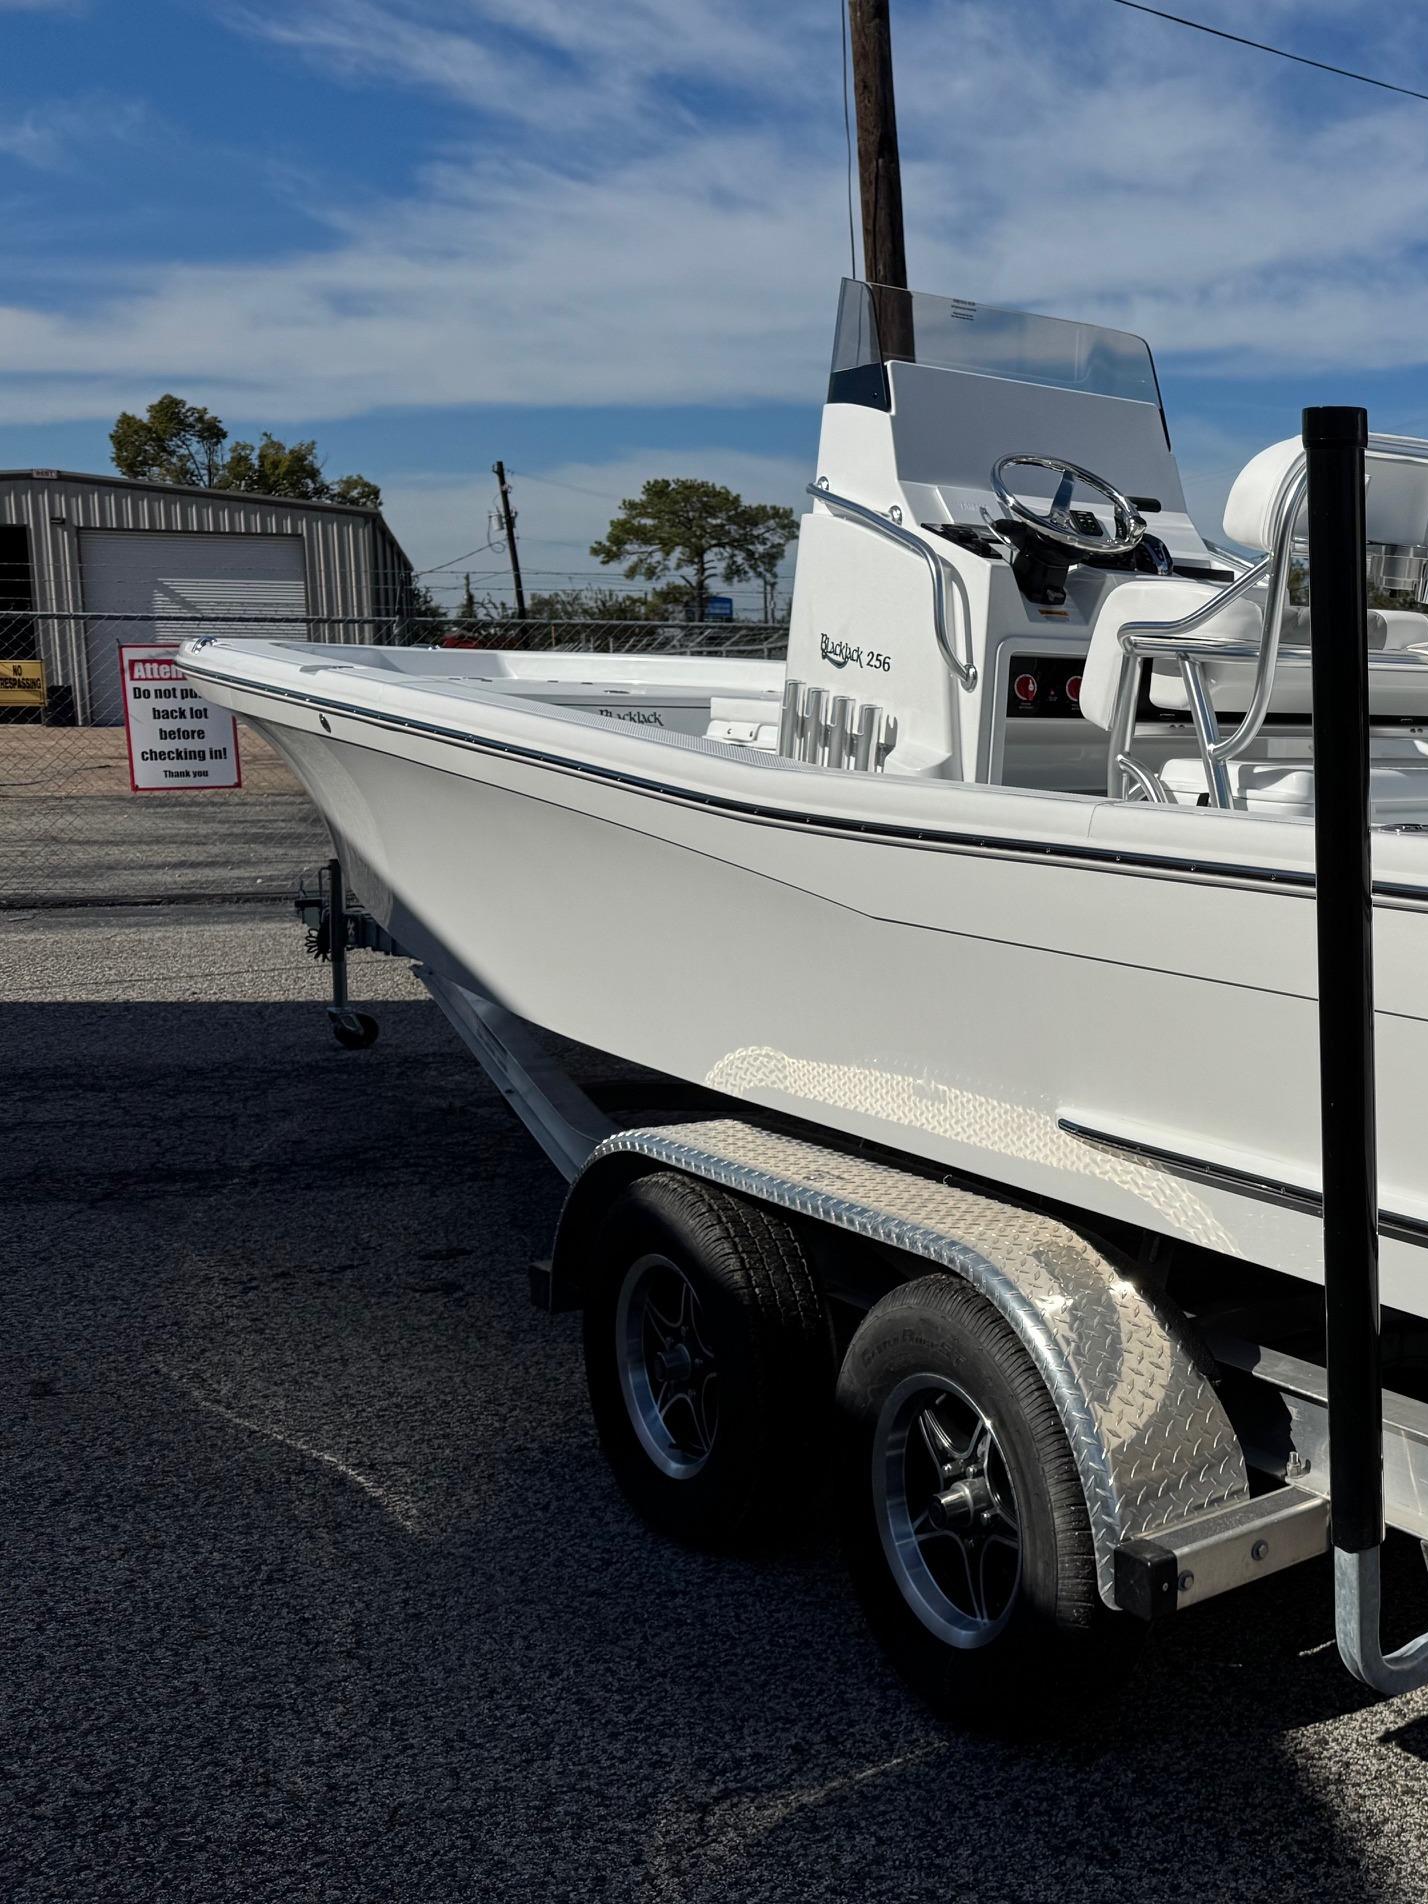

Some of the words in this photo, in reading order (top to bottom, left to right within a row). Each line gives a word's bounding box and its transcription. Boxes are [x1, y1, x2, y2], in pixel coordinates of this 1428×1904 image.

[866, 651, 892, 672] 256
[13, 665, 22, 677] NO
[133, 662, 184, 679] Atten
[0, 677, 41, 689] RESPASSING
[133, 687, 150, 699] Do
[154, 687, 177, 699] not
[152, 707, 187, 719] back
[190, 707, 208, 719] lot
[159, 728, 206, 740] before
[141, 748, 206, 761] checking
[209, 747, 227, 760] in!
[163, 769, 190, 778] Thank
[192, 769, 209, 778] you
